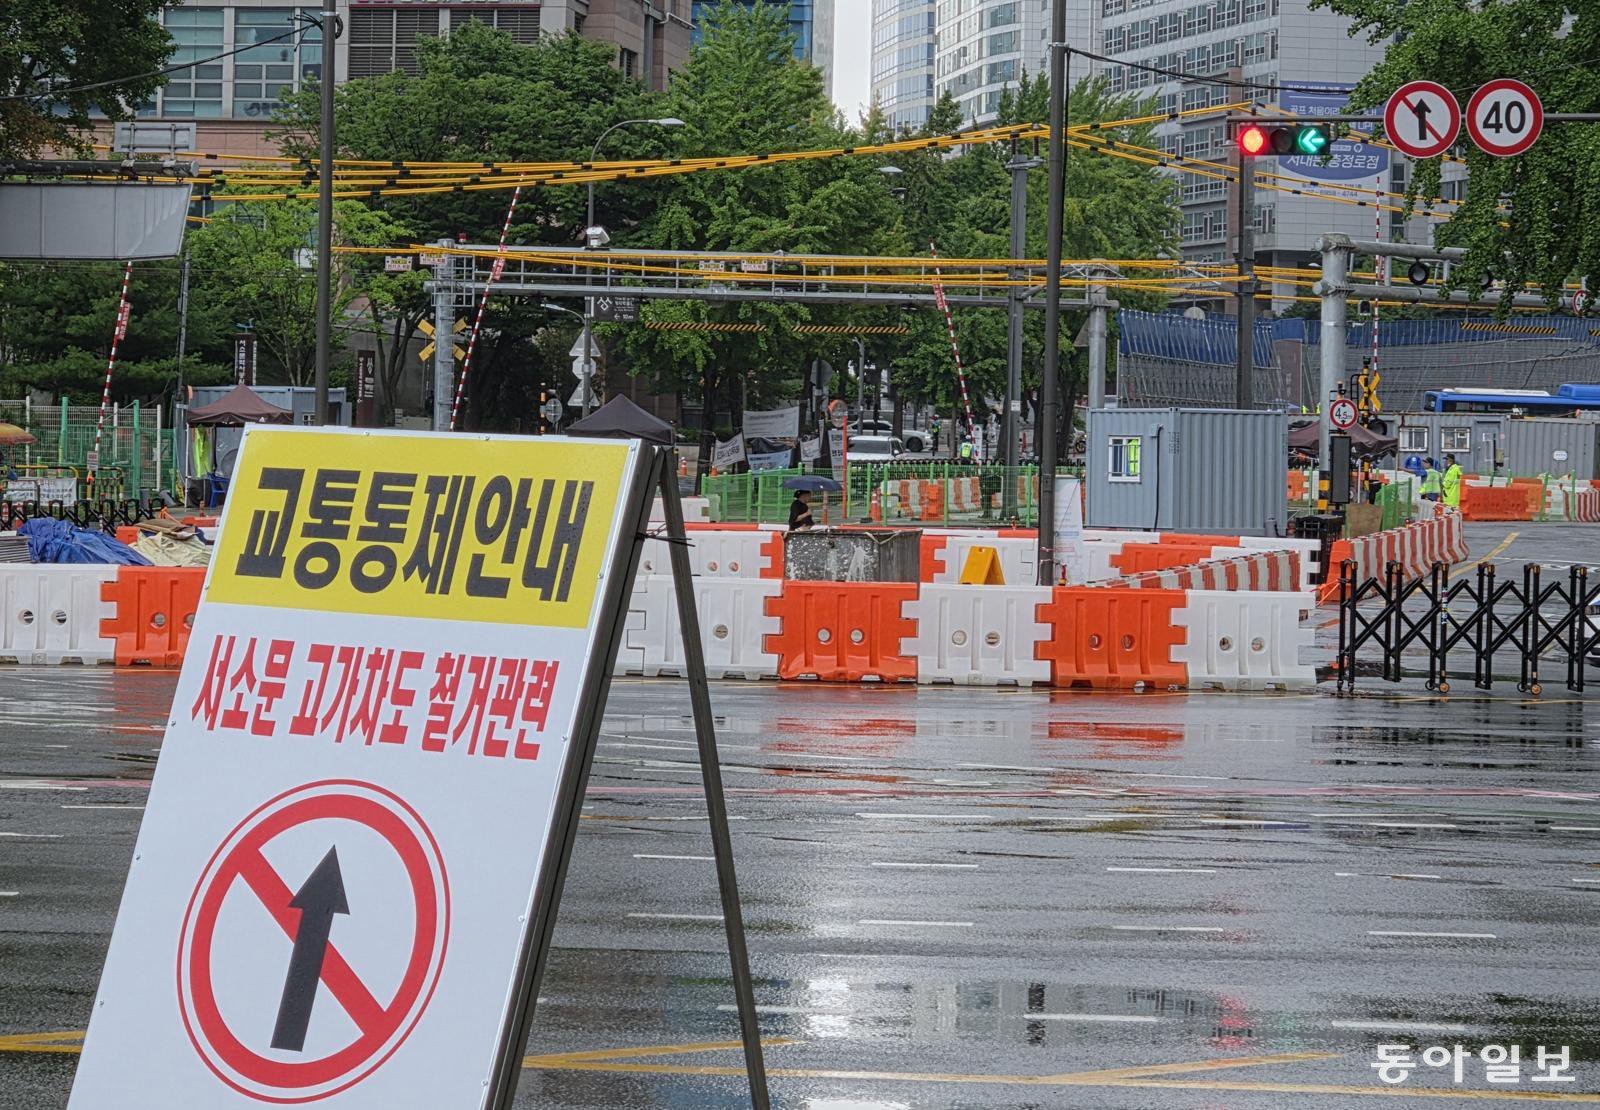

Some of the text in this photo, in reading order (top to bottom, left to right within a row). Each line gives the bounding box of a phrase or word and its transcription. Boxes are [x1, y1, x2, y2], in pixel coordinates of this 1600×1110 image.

[1482, 100, 1526, 134] 40
[234, 466, 595, 603] 교통통제안내
[191, 634, 560, 761] 서소문 고가차도 철거관련
